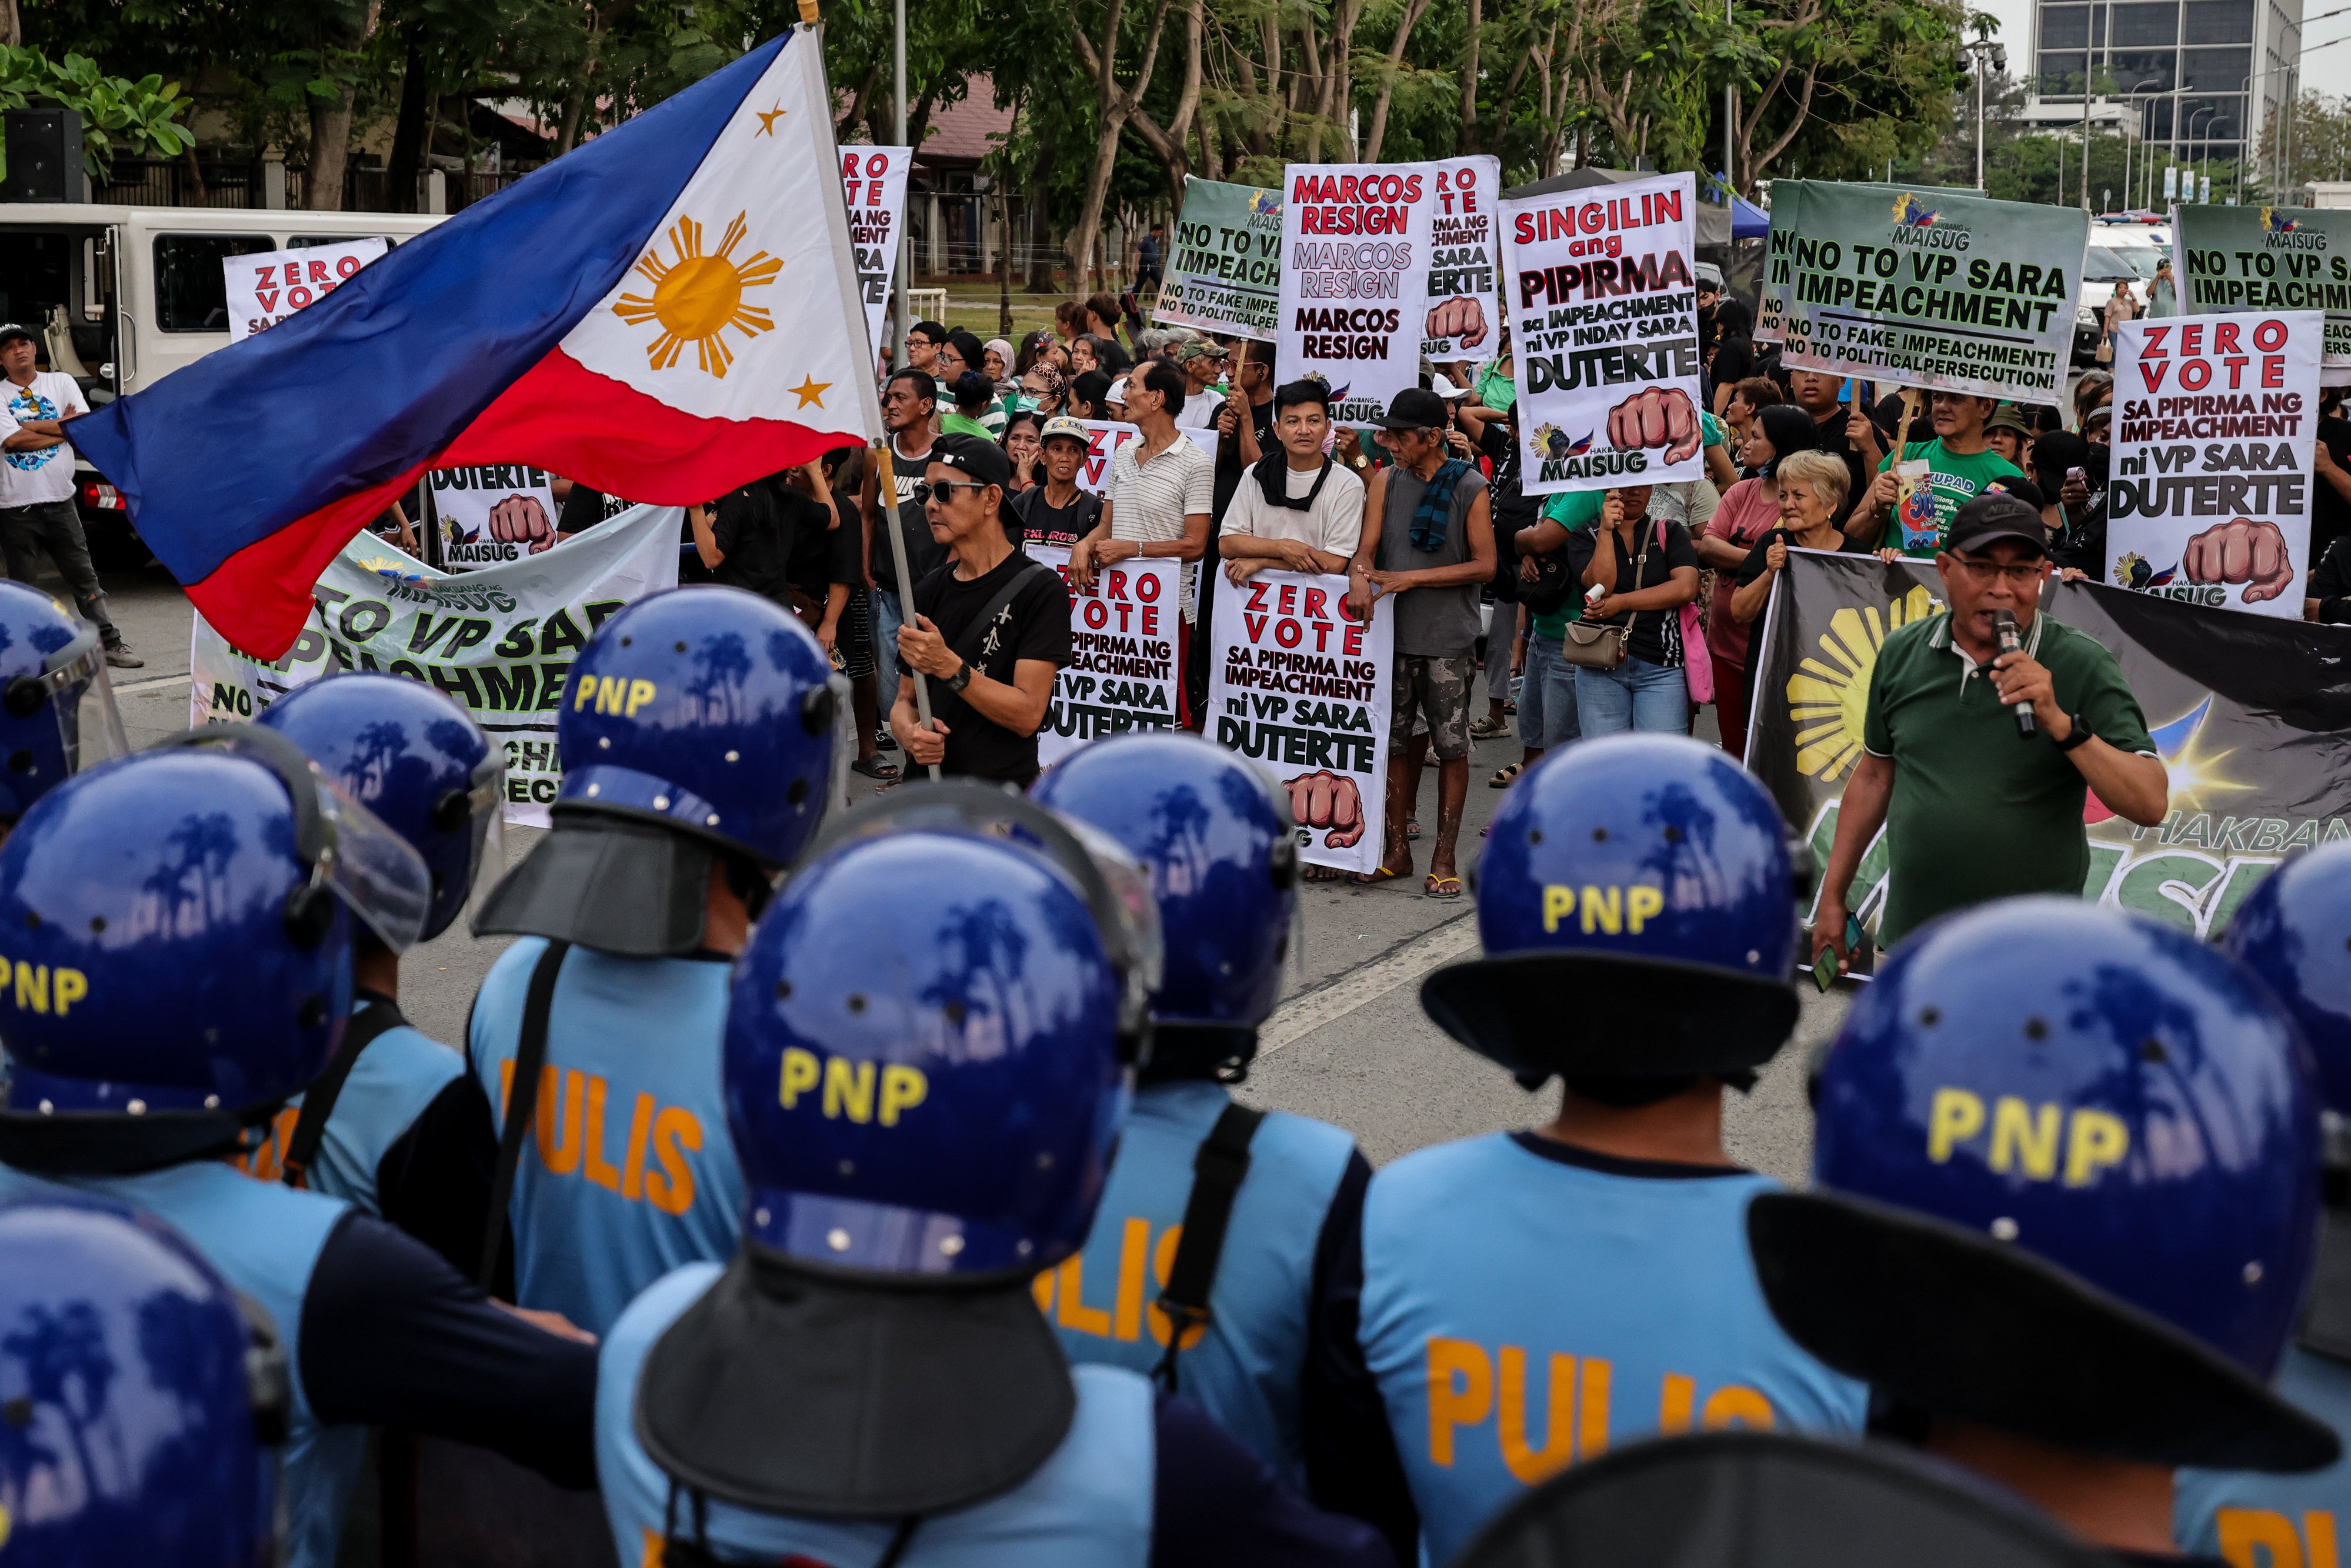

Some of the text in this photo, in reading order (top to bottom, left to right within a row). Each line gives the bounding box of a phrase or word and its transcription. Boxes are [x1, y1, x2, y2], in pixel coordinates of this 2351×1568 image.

[842, 153, 889, 179] RO
[1436, 167, 1476, 192] RO
[846, 180, 885, 206] TE
[1292, 174, 1423, 204] MARCOS
[1439, 191, 1477, 215] TE
[865, 209, 891, 226] NG
[1246, 213, 1283, 232] MAIS
[1300, 205, 1409, 235] RES!GN
[1465, 214, 1488, 229] NG
[1514, 189, 1683, 245] SINGILIN
[1178, 221, 1212, 248] NO
[1219, 227, 1251, 255] TO
[1569, 235, 1622, 258] ang
[1890, 224, 1971, 252] MAISUG
[2265, 231, 2327, 251] MAISUG
[856, 248, 885, 271] RA
[1175, 248, 1280, 287] IMPEACH
[1292, 242, 1412, 270] MARCOS
[1431, 246, 1488, 268] SARA
[1795, 236, 1842, 272] NO
[1852, 244, 1899, 278] TO
[1912, 251, 1958, 285] VP
[1967, 258, 2067, 301] SARA
[2186, 248, 2227, 276] NO
[2234, 251, 2276, 278] TO
[2284, 252, 2322, 279] VP
[255, 255, 361, 291] ZERO
[1300, 271, 1399, 299] RES!GN
[1428, 265, 1492, 297] ERTE
[1519, 249, 1695, 309] PIPIRMA
[1159, 298, 1177, 312] NO
[1180, 302, 1196, 315] TO
[1164, 283, 1184, 298] NO
[1188, 287, 1205, 302] TO
[1208, 291, 1243, 309] FAKE
[1765, 298, 1783, 314] NO
[1796, 271, 2059, 333] IMPEACHMENT
[1295, 308, 1400, 333] MARCOS
[1522, 292, 1695, 333] sa IMPEACHMENT
[1762, 315, 1779, 329] NO
[1302, 334, 1389, 360] RES!GN
[1420, 340, 1452, 355] SUG
[1525, 315, 1694, 353] ni VP INDAY SARA
[1785, 338, 1806, 354] NO
[1811, 342, 1832, 358] TO
[1788, 318, 2057, 370] NO TO FAKE IMPEACHMENT!
[2139, 319, 2289, 359] ZERO
[1526, 337, 1699, 395] DUTERTE
[2137, 354, 2285, 394] VOTE
[1328, 403, 1385, 422] AISUG
[2122, 392, 2303, 421] SA PIPIRMA NG
[2120, 414, 2303, 443] IMPEACHMENT
[1539, 452, 1648, 483] MAISUG
[2119, 442, 2299, 476] ni VP SARA
[2108, 473, 2305, 519] DUTERTE
[448, 543, 519, 562] MAISUG
[406, 610, 494, 660] VP
[1071, 631, 1172, 661] PIPIRMA NG
[1243, 612, 1364, 657] VOTE
[1071, 650, 1172, 680] EACHMENT
[1226, 645, 1376, 681] SA PIPIRMA NG
[574, 674, 656, 717] PNP
[1063, 673, 1096, 702] VP
[1099, 678, 1169, 711] SARA
[1224, 664, 1376, 703] IMPEACHMENT
[212, 682, 253, 717] NO
[1226, 692, 1373, 733] ni VP SARA
[1217, 715, 1376, 774] DUTERTE
[1542, 885, 1665, 935] PNP
[779, 1048, 928, 1127] PNP
[1928, 1088, 2130, 1187] PNP
